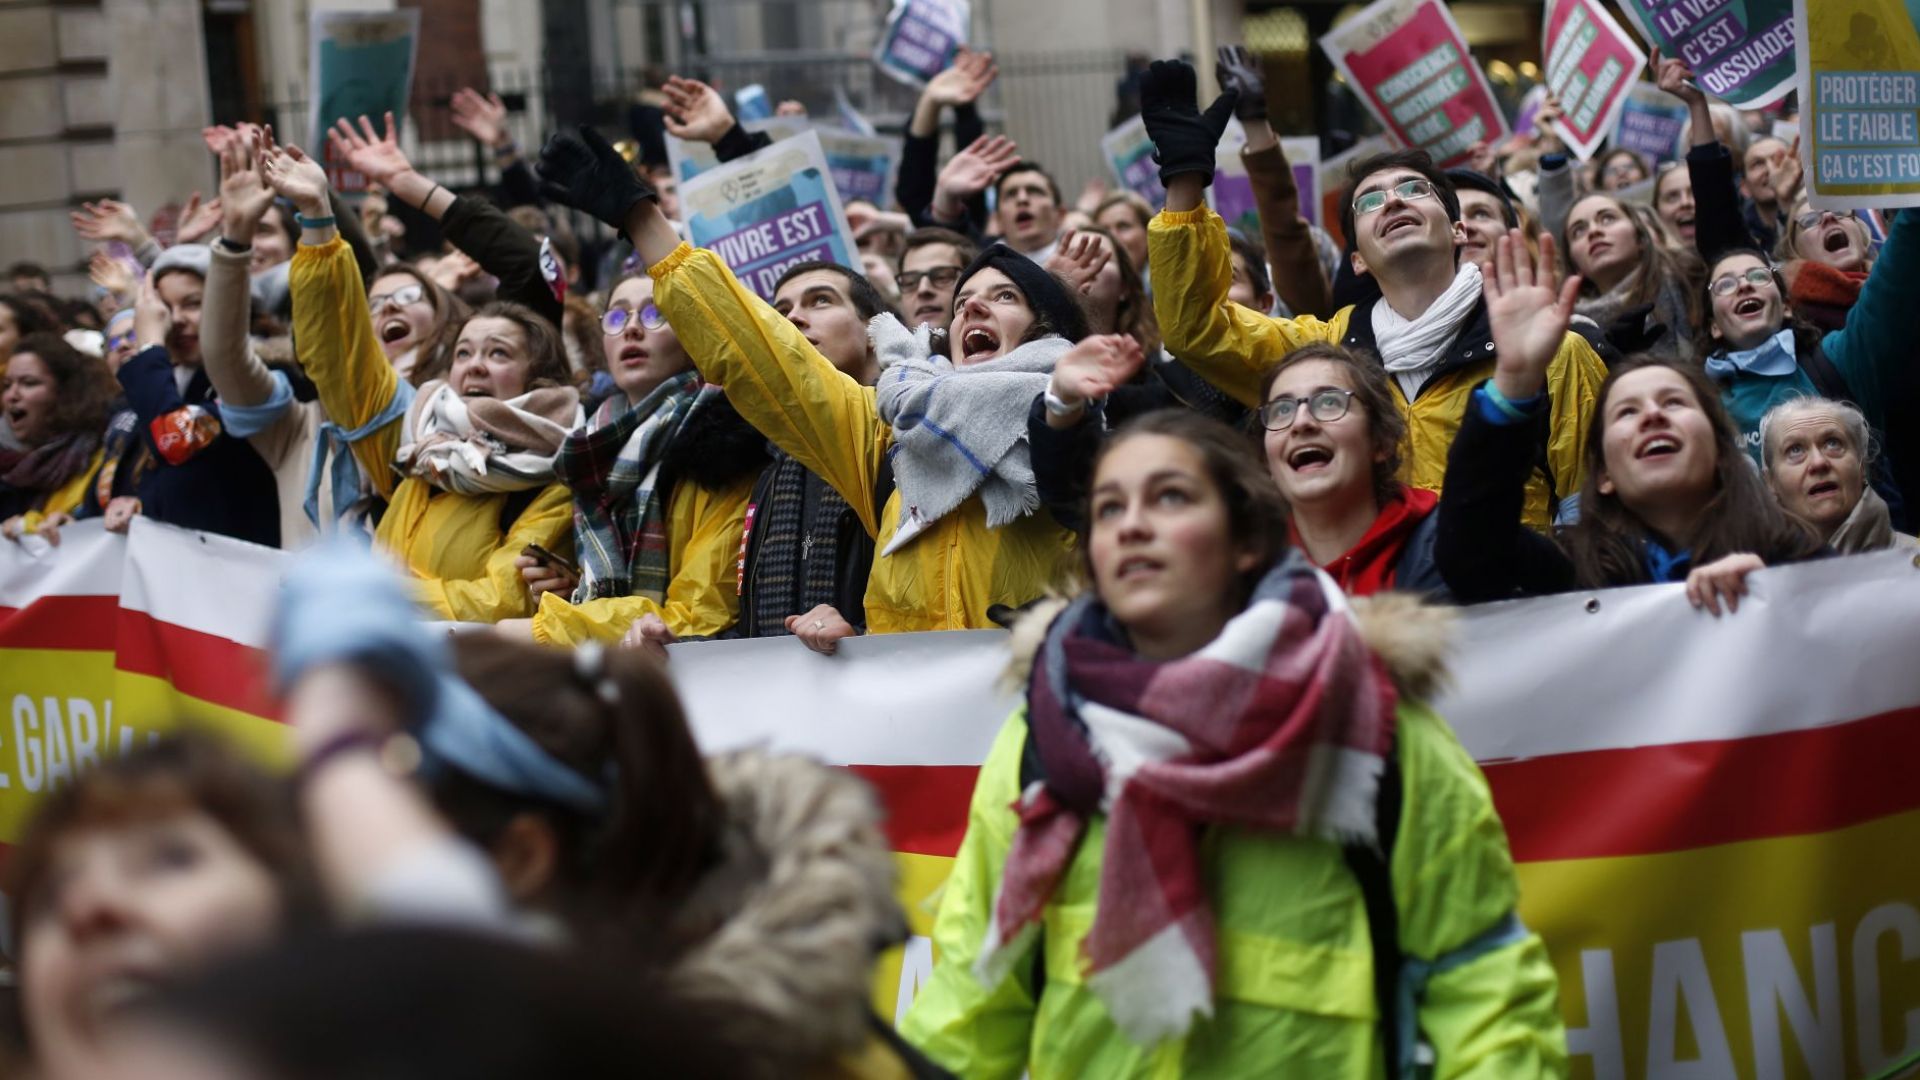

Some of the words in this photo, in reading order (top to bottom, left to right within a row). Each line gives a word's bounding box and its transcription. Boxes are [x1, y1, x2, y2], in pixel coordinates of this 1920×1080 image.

[1660, 7, 1691, 38] LA
[1682, 17, 1736, 66] C'EST
[1820, 72, 1917, 104] PROTÉGER
[1821, 113, 1843, 141] LE
[1848, 113, 1913, 141] FAIBLE
[1822, 155, 1844, 183] ÇA
[1847, 154, 1894, 178] C'EST
[1898, 153, 1920, 177] FO
[709, 222, 779, 267] VIVRE
[777, 206, 822, 247] EST
[12, 694, 134, 793] GAR
